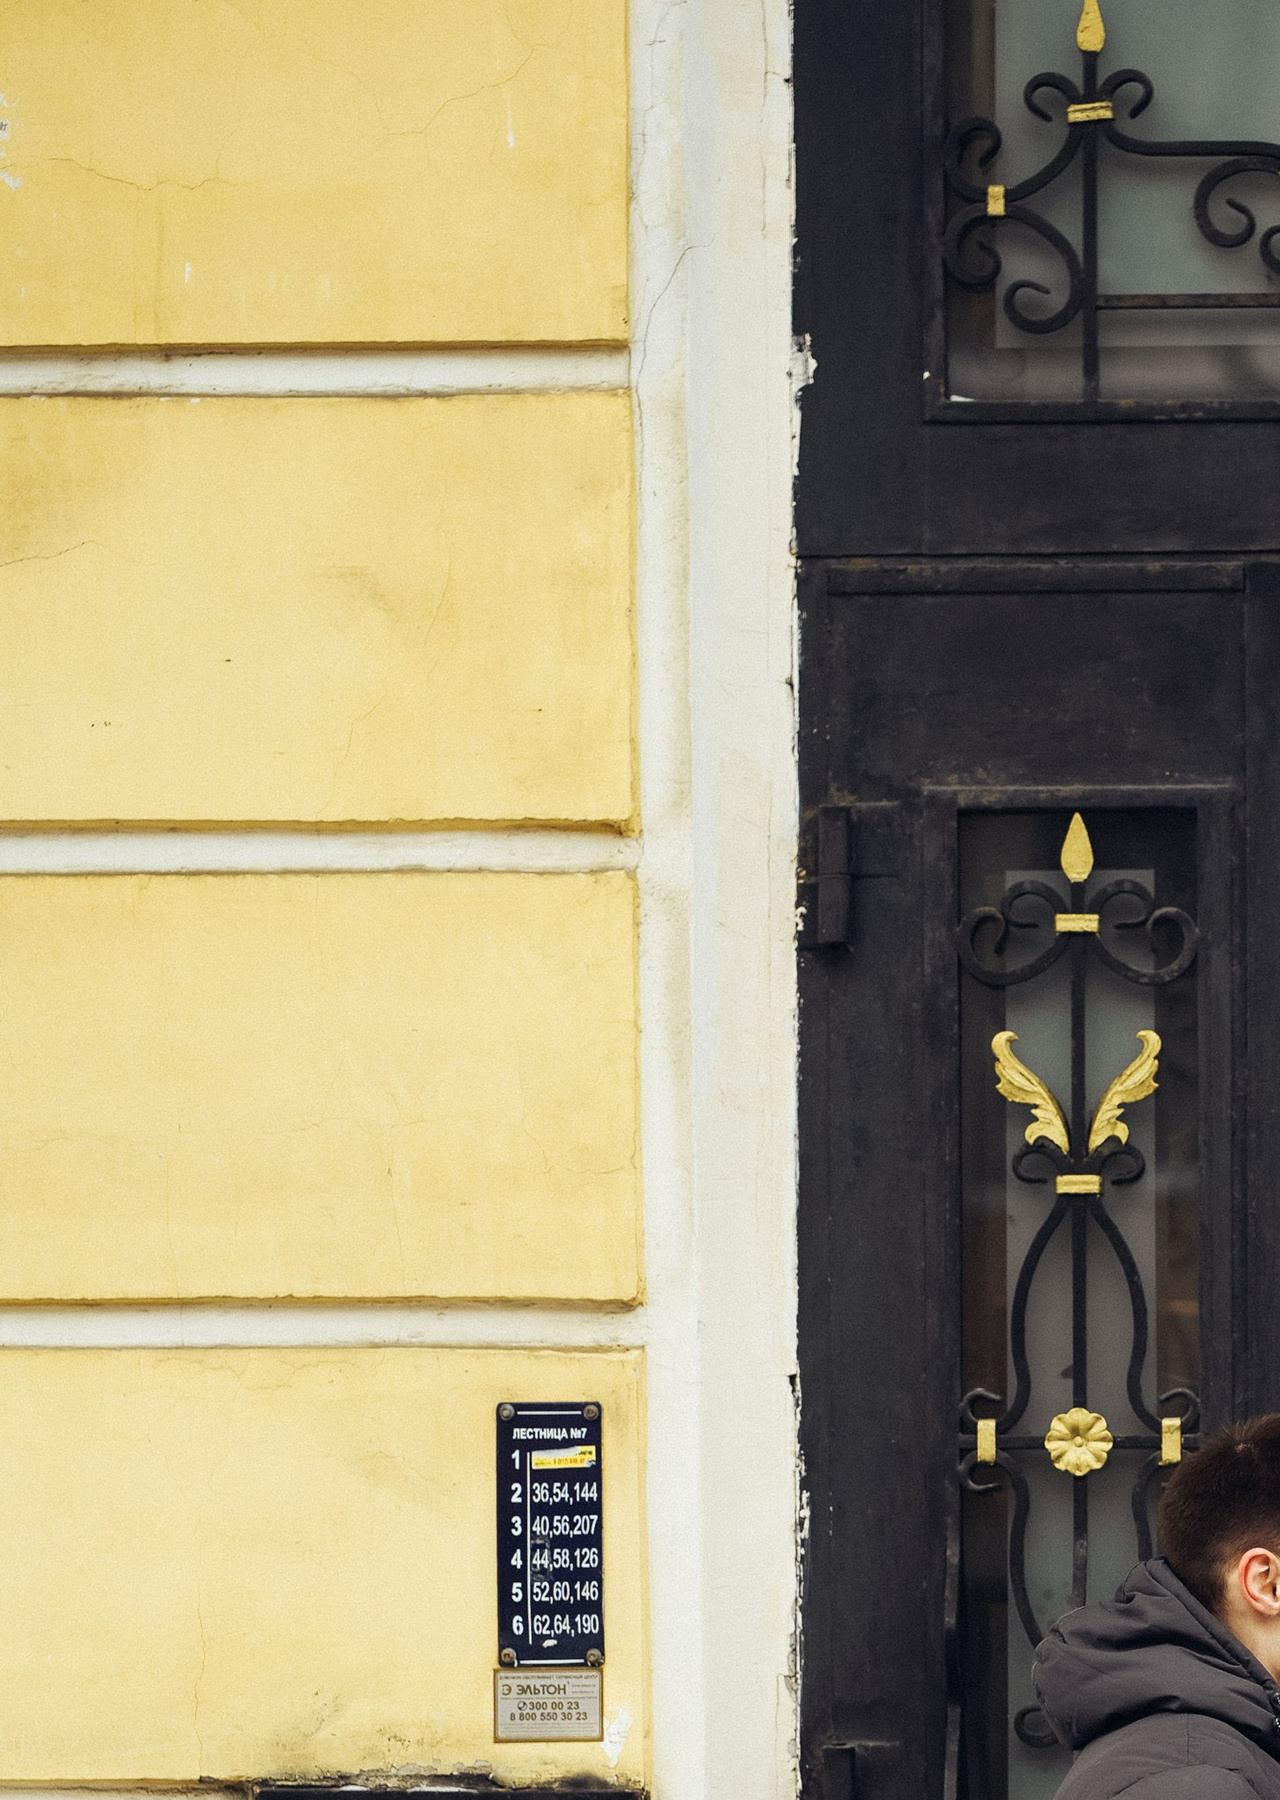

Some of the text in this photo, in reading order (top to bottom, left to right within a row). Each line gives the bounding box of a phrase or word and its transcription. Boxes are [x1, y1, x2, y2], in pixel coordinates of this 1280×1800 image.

[512, 1427, 588, 1441] ЛЕСТНИЦА №7
[511, 1449, 520, 1470] 1
[510, 1481, 598, 1506] 2 36,54,144
[511, 1514, 599, 1539] 3 40,56,207
[510, 1548, 599, 1571] 4 44,58,126
[511, 1581, 599, 1605] 5 52,60,146
[512, 1614, 600, 1638] 6 62,64,190
[516, 1684, 566, 1695] ЭЛЬТОН
[510, 1712, 588, 1721] 8 800 550 30 23
[529, 1701, 580, 1710] 300 00 23
